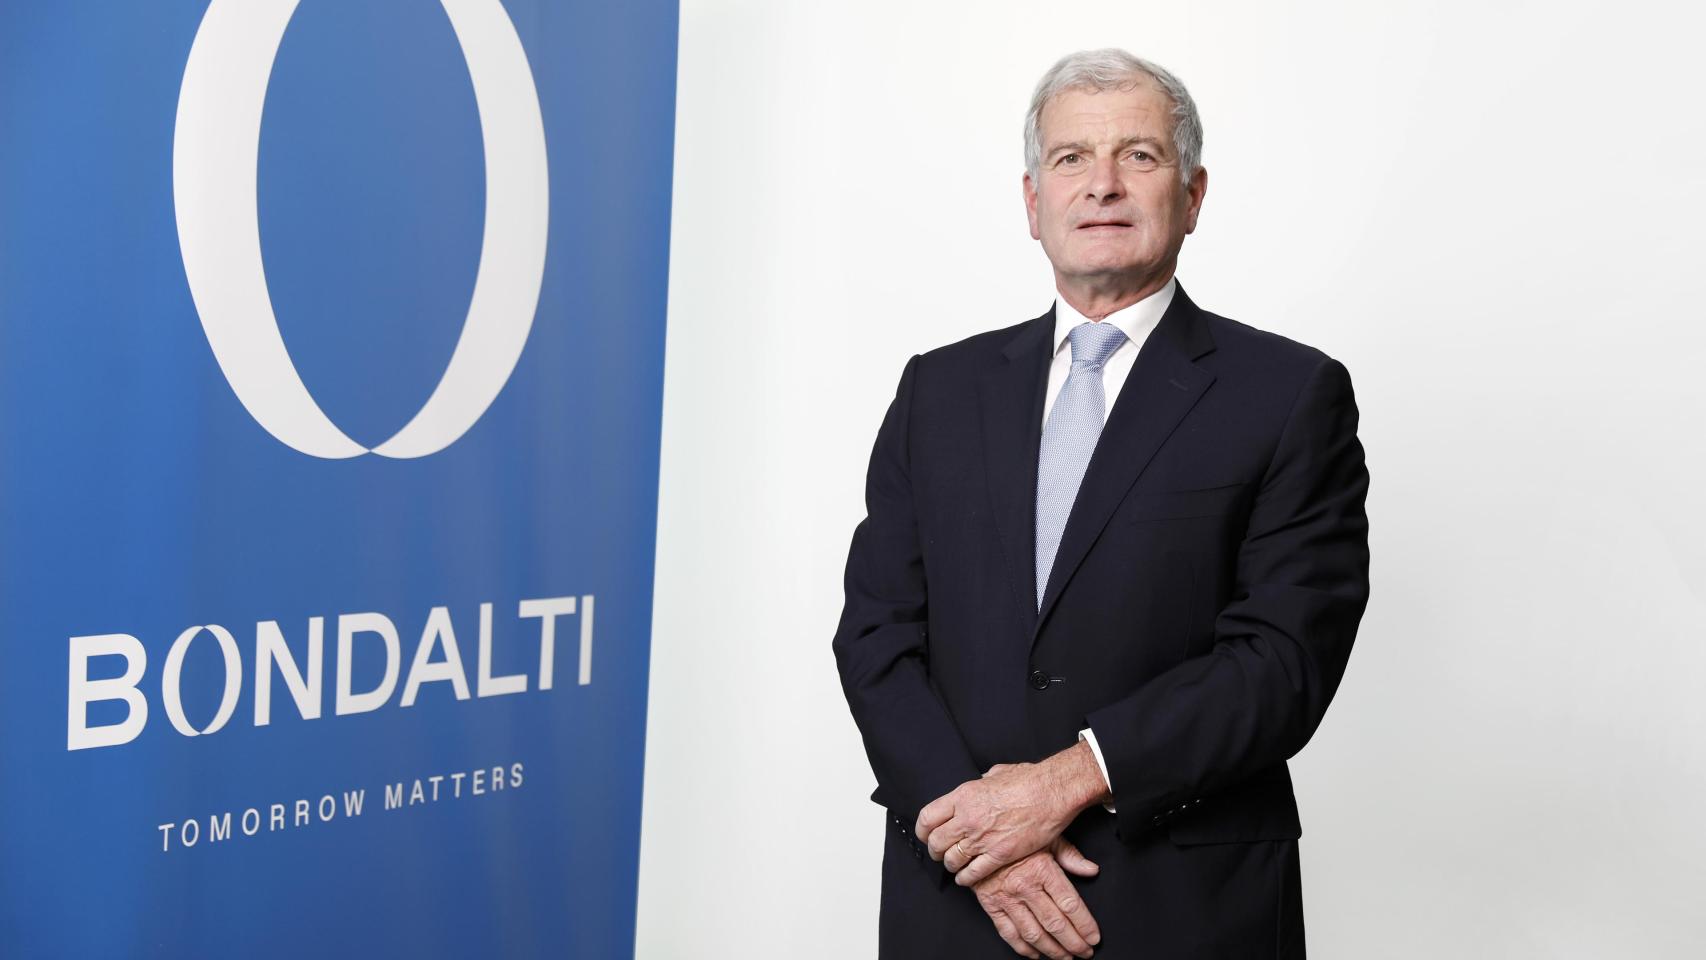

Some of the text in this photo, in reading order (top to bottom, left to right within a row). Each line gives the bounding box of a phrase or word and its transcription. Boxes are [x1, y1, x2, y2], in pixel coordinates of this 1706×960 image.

[67, 594, 595, 751] BONDALTI
[158, 762, 525, 853] TOMORROW MATTERS
